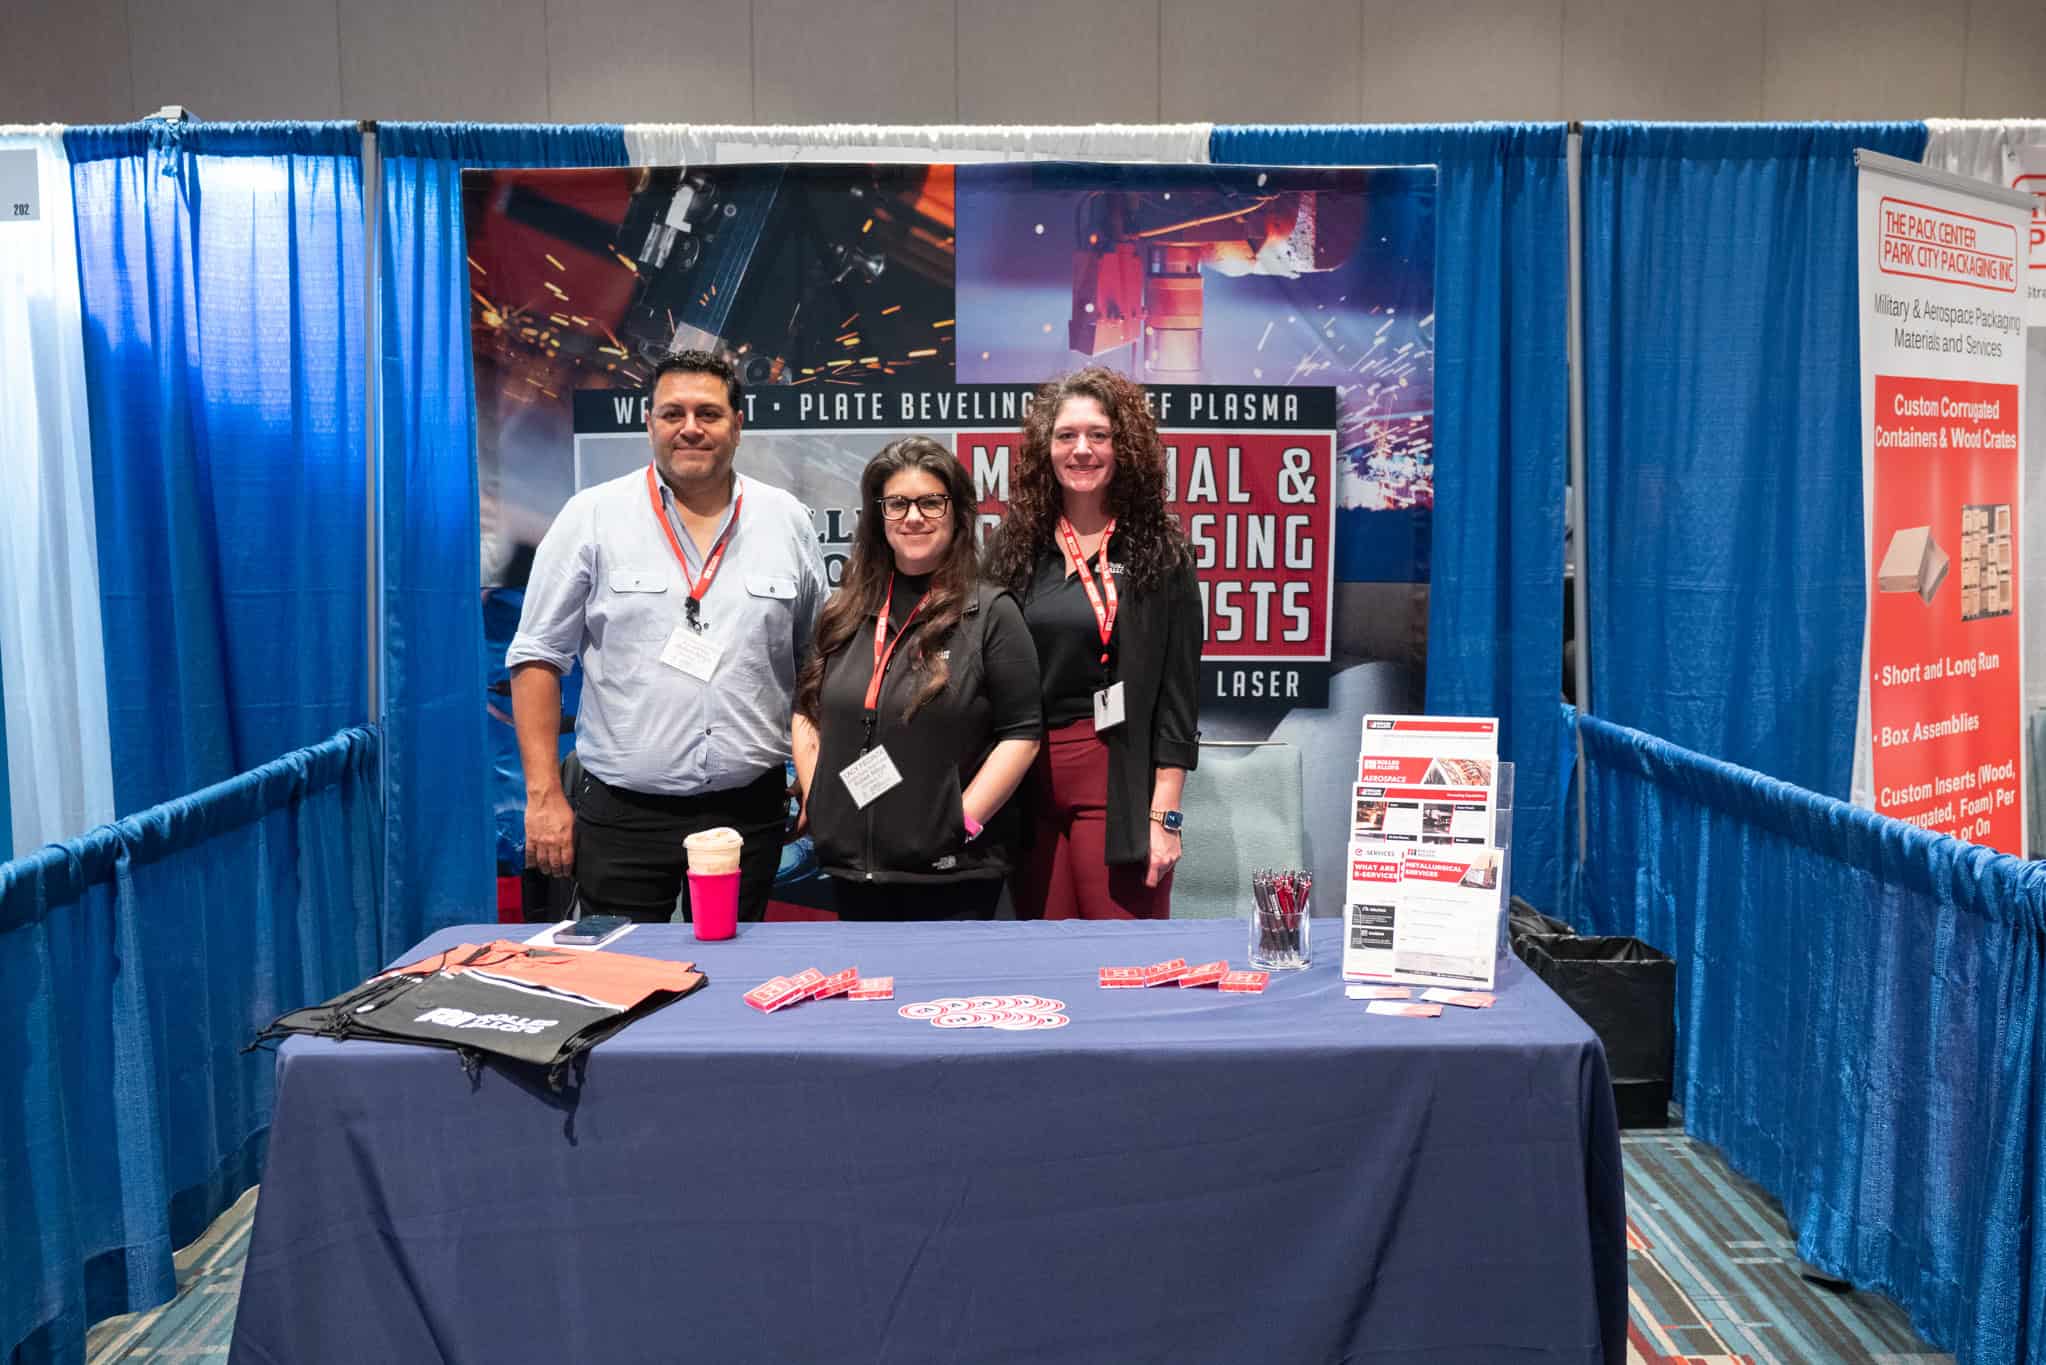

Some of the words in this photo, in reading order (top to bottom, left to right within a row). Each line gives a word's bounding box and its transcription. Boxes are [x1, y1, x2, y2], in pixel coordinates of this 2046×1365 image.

[13, 203, 31, 216] 202
[1886, 210, 1906, 235] THE
[1909, 215, 1937, 240] PACK
[1939, 222, 1976, 249] CENTER
[1884, 240, 1914, 266] PARK
[1917, 246, 1940, 269] CITY
[1941, 250, 1997, 279] PACKAGING
[1999, 262, 2014, 282] INC
[1874, 293, 1910, 322] Military
[1912, 298, 1921, 319] &
[1923, 300, 1973, 327] Aerospace
[1975, 307, 2021, 336] Packaging
[1894, 327, 1941, 351] Materials
[1942, 333, 1963, 353] and
[1966, 335, 2002, 357] Services
[800, 393, 883, 421] PLATE
[901, 391, 1034, 420] BEVELING
[1190, 393, 1298, 421] PLASMA
[1894, 393, 1939, 417] Custom
[1940, 396, 2000, 423] Corrugated
[1875, 425, 1937, 448] Containers
[1939, 427, 1947, 448] &
[1951, 427, 1981, 449] Wood
[1983, 428, 2016, 449] Crates
[1278, 447, 1316, 504] &
[1217, 670, 1300, 697] LASER
[1882, 664, 1921, 687] Short
[1923, 658, 1944, 681] and
[1945, 656, 1977, 678] Long
[1978, 652, 2000, 672] Run
[1881, 726, 1909, 747] Box
[1913, 712, 1979, 742] Assemblies
[1880, 783, 1932, 807] Custom
[1935, 771, 1976, 796] Inserts
[1978, 760, 2016, 789] (Wood,
[1959, 792, 1993, 818] Foam)
[1996, 788, 2015, 809] Per
[1976, 818, 1990, 837] On
[1355, 863, 1377, 871] WHAT
